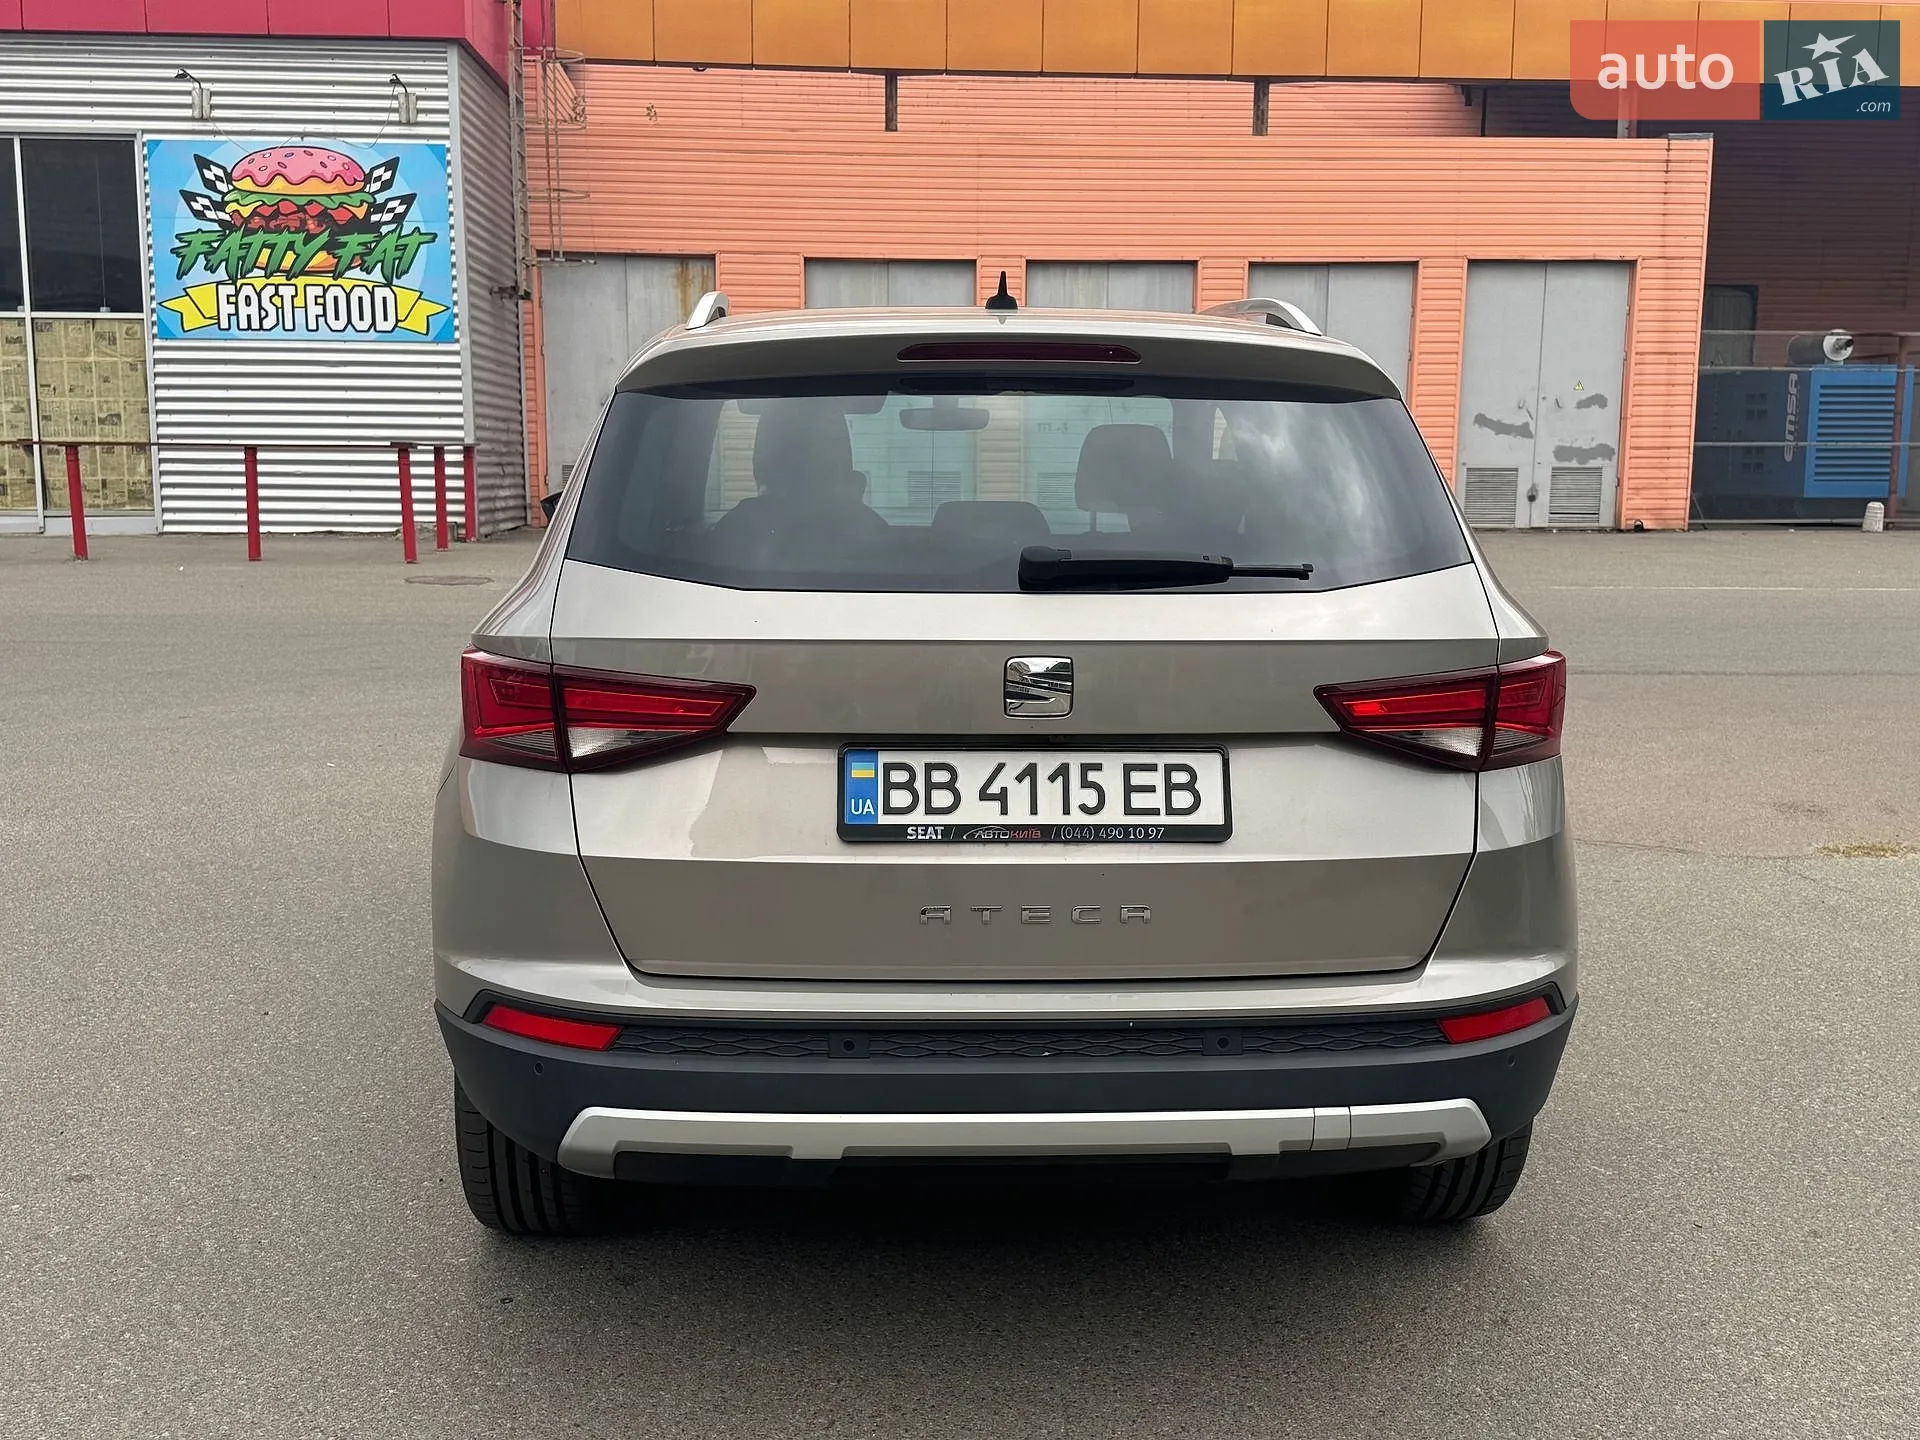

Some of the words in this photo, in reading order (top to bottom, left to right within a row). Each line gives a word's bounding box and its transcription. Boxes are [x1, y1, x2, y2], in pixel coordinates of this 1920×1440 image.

[170, 226, 330, 281] FATTY
[326, 224, 438, 285] FAT
[216, 283, 298, 331] FAST
[304, 283, 399, 333] FOOD
[882, 762, 962, 816] BB
[978, 762, 1106, 816] 4115
[1123, 762, 1202, 816] EB
[850, 798, 875, 816] UA
[907, 826, 945, 840] SEAT
[1060, 826, 1095, 840] (044)
[1099, 827, 1124, 839] 490
[1128, 827, 1144, 839] 10
[1148, 827, 1165, 839] 97
[919, 904, 1152, 925] ATECA
